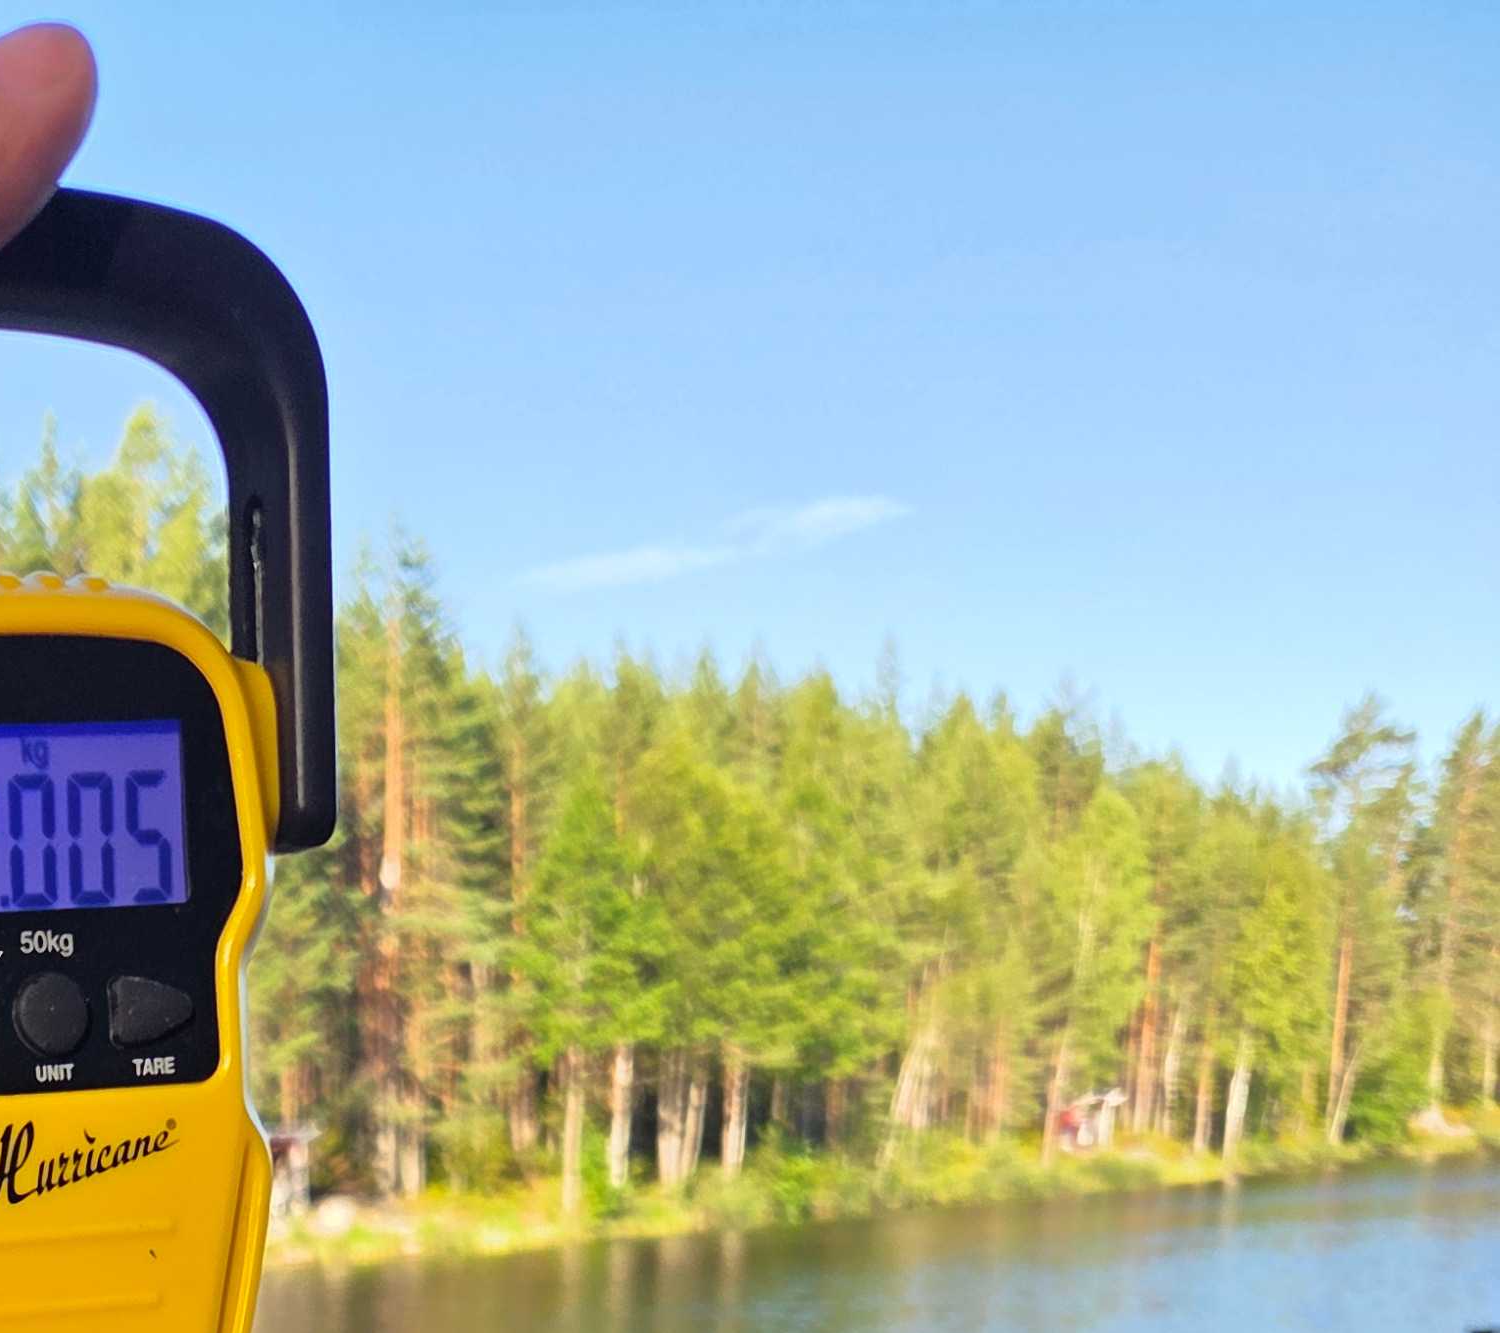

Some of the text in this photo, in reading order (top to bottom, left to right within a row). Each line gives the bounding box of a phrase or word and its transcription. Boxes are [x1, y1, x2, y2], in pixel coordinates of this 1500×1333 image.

[21, 737, 49, 769] kg
[20, 930, 74, 957] 50kg
[35, 1063, 74, 1082] UNIT
[132, 1056, 175, 1076] TARE
